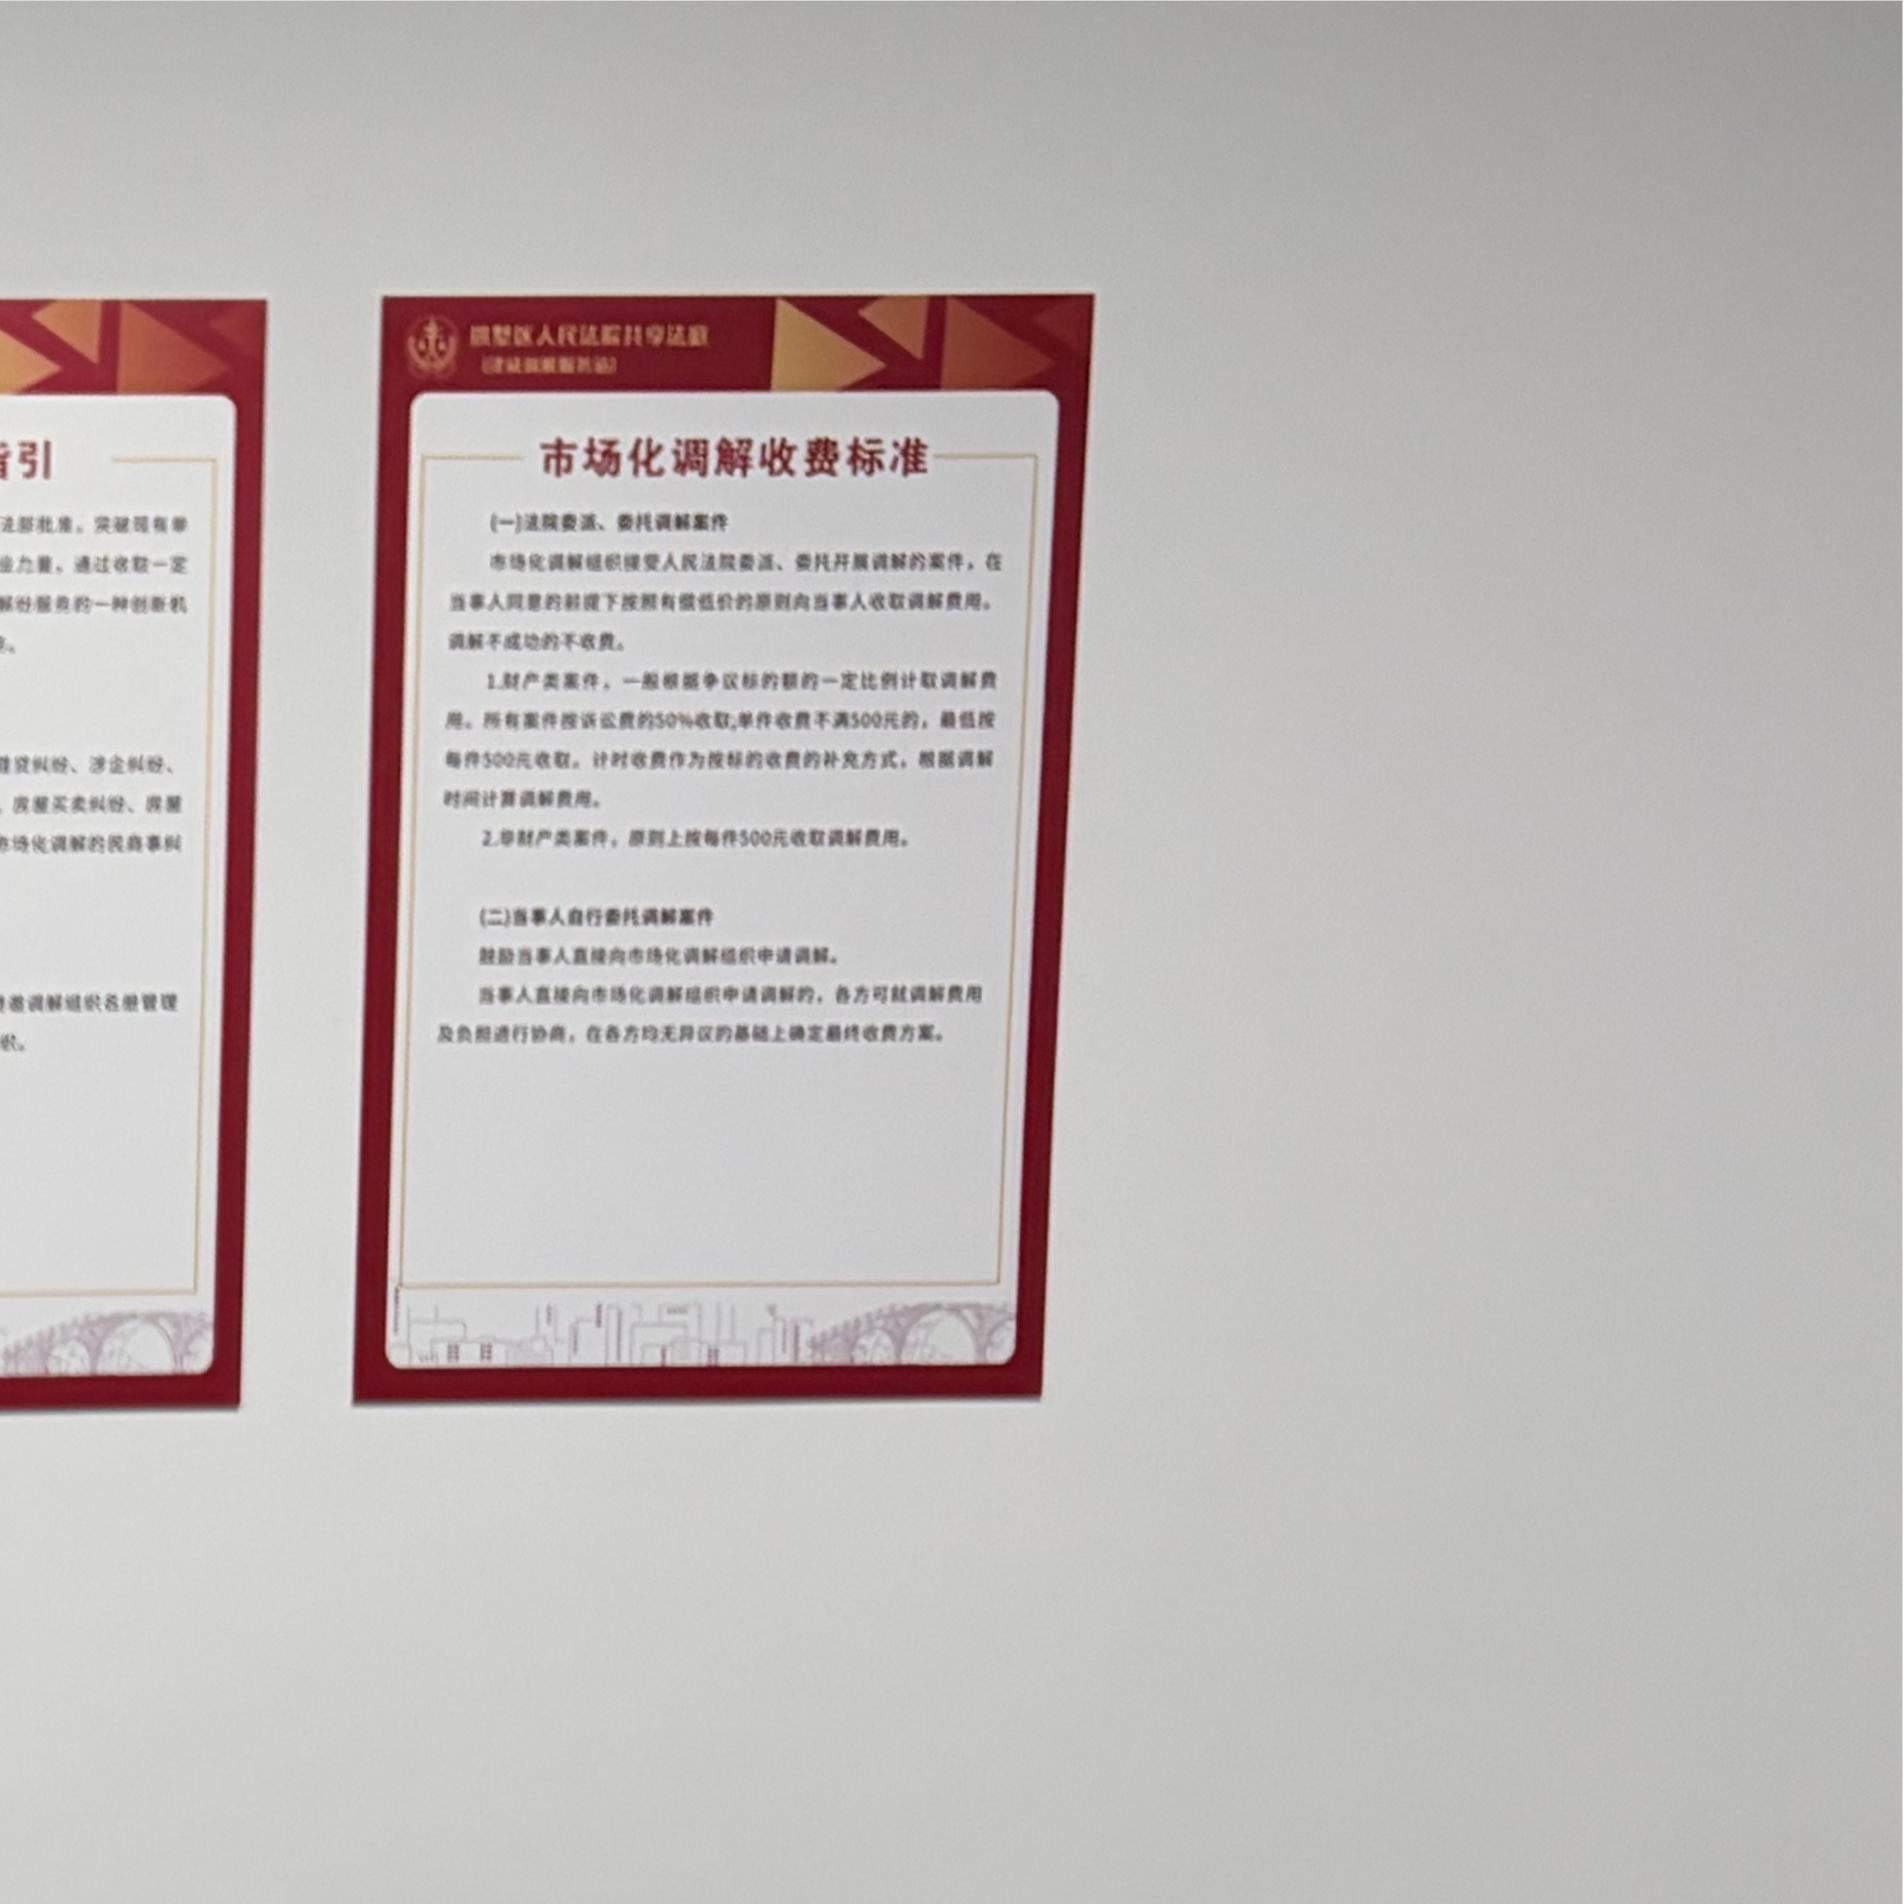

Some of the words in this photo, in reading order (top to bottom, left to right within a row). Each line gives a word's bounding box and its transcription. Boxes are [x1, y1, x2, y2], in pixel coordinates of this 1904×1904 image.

[541, 437, 928, 478] 市场化调解收费标准
